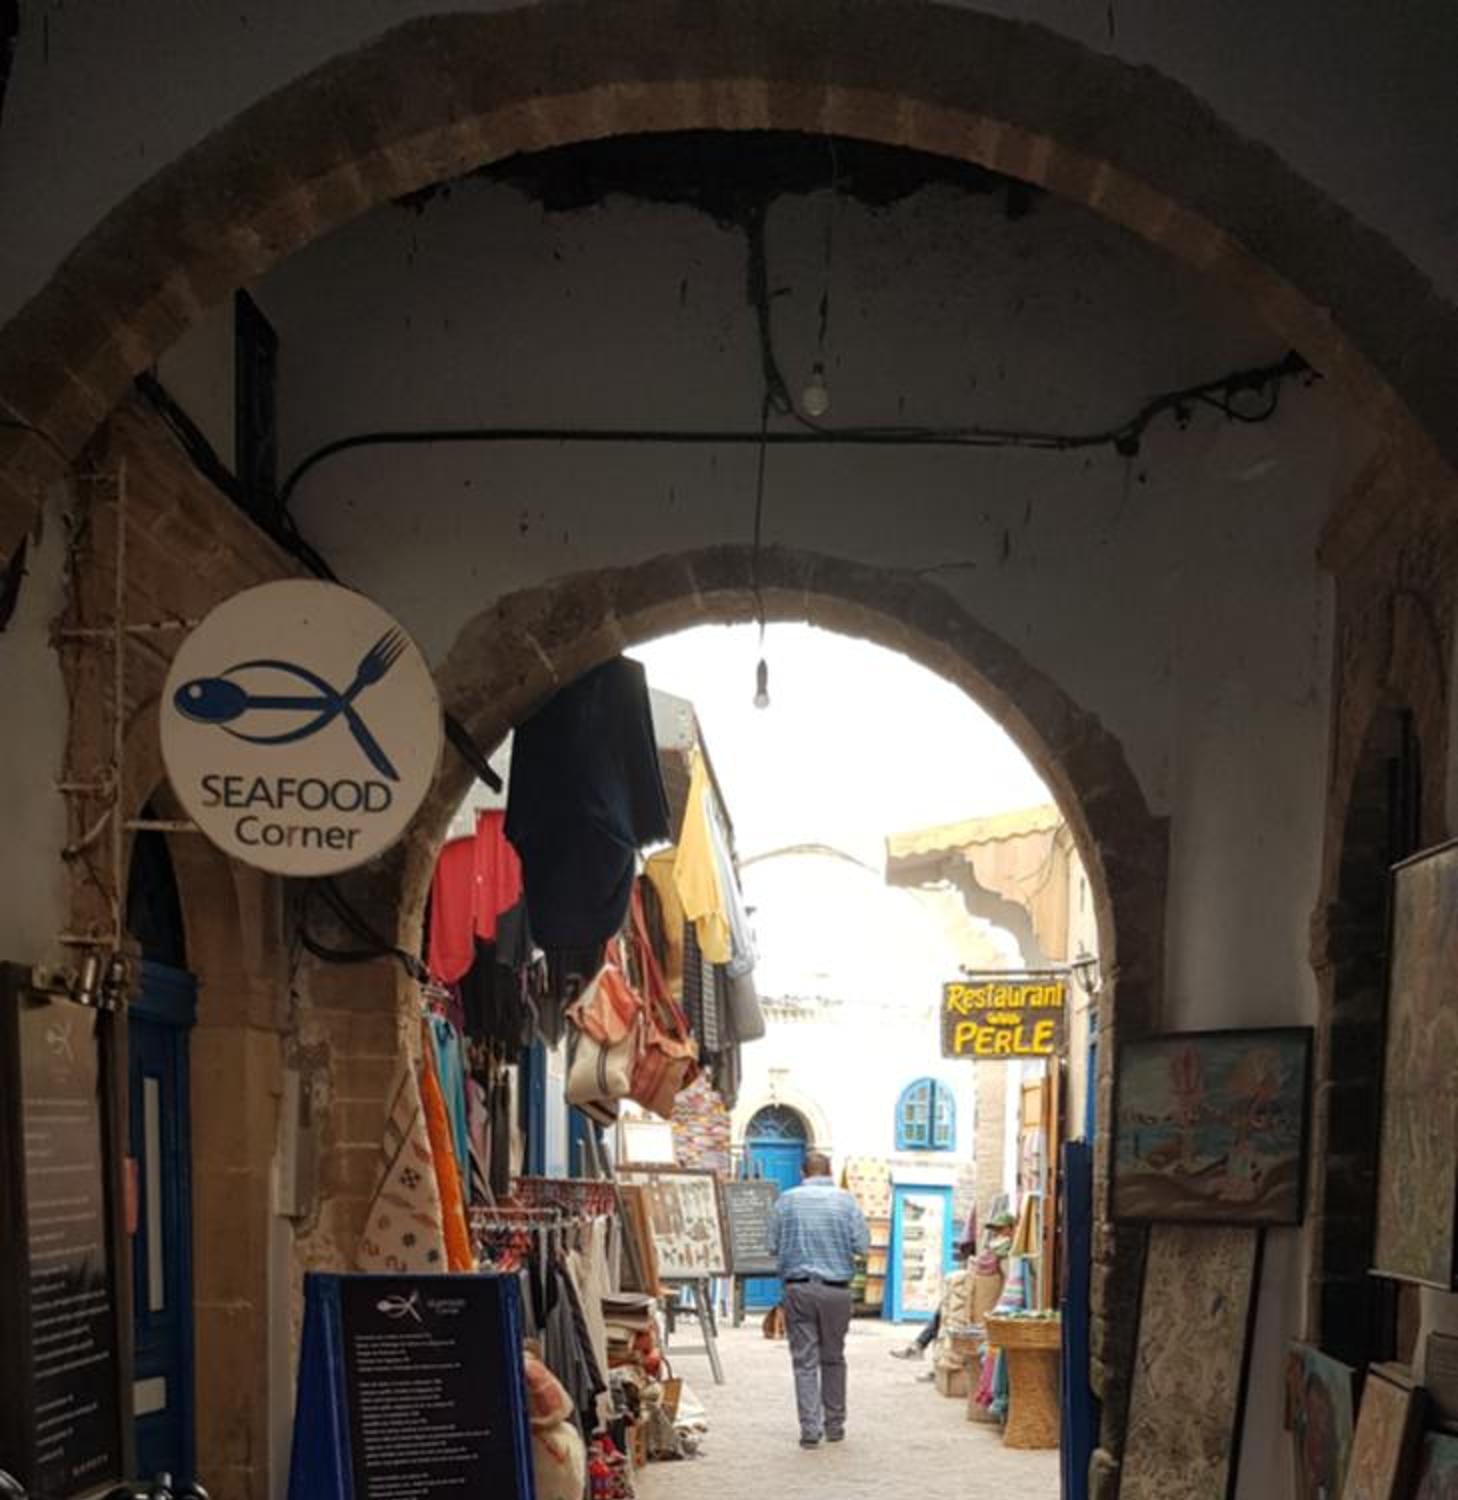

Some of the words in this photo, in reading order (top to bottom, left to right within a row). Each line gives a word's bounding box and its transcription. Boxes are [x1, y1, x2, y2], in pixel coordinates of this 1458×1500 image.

[200, 774, 393, 813] SEAFOOD
[235, 815, 362, 849] Corner
[947, 980, 1063, 1015] Restaurant
[953, 1019, 1056, 1056] PERLE
